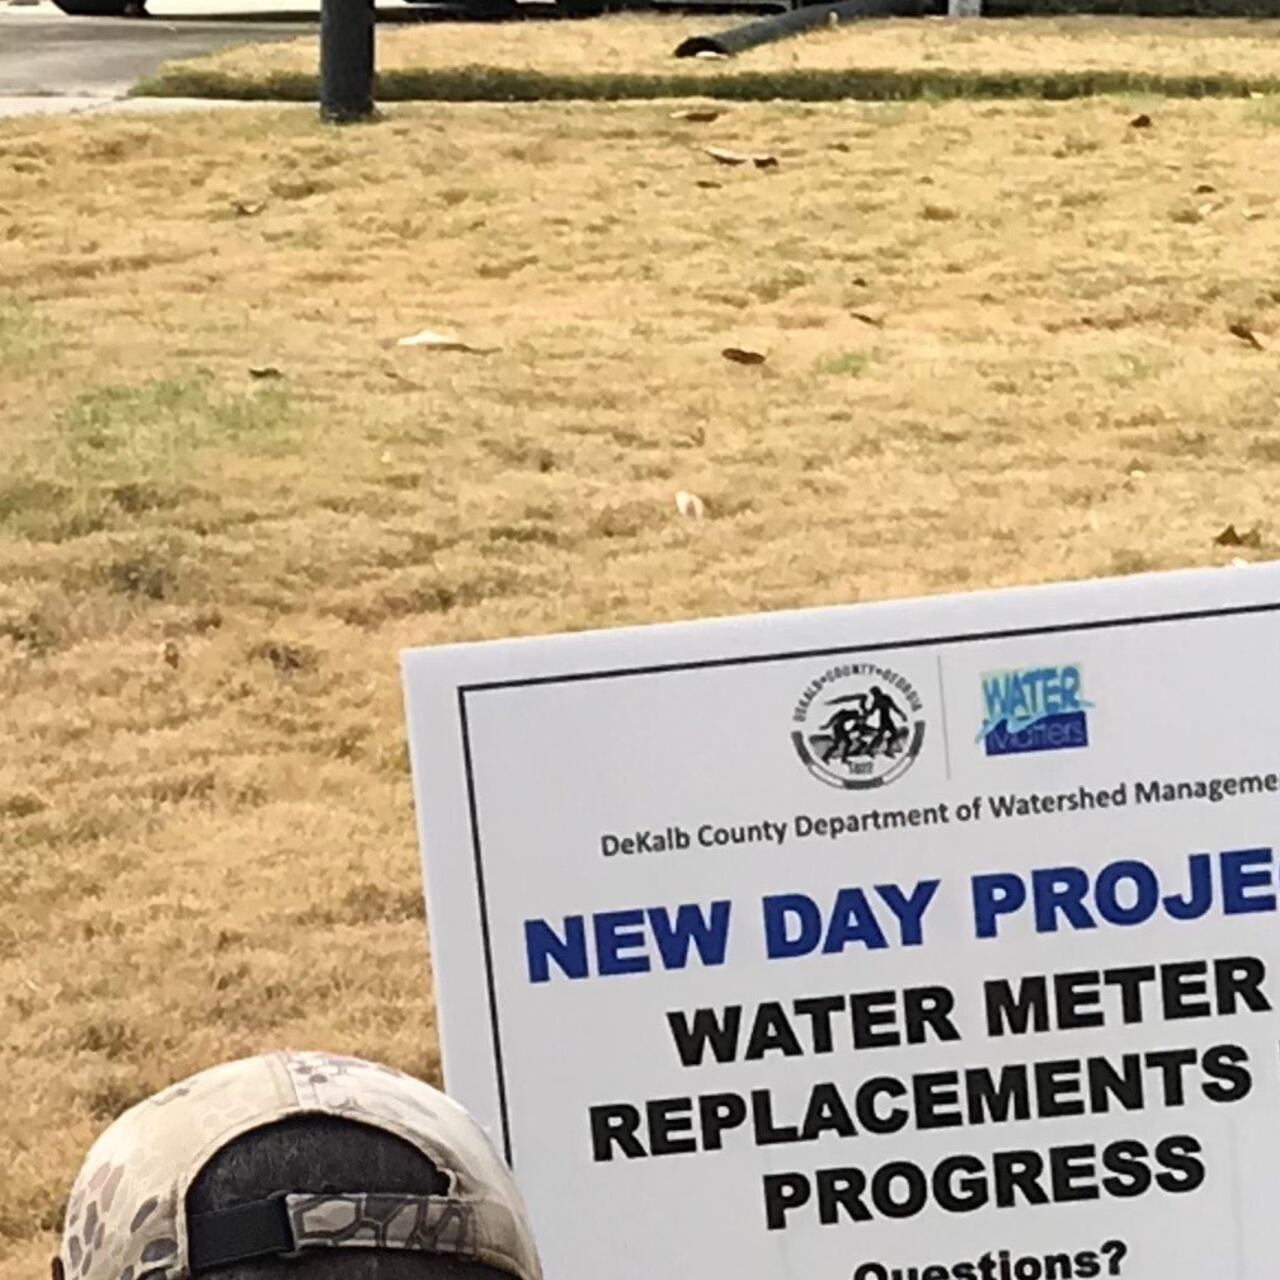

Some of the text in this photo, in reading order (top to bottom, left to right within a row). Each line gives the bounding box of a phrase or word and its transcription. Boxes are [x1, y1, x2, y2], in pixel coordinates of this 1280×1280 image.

[981, 665, 1081, 718] WATER
[985, 720, 1085, 751] Matters
[601, 827, 691, 858] DeKalb
[697, 820, 787, 849] County
[794, 803, 949, 841] Department
[955, 796, 982, 822] of
[988, 782, 1127, 819] Watershed
[523, 899, 732, 984] NEW
[761, 879, 941, 960] DAY
[665, 956, 1273, 1068] WATER METER
[588, 1044, 1253, 1163] REPLACEMENTS
[762, 1134, 1206, 1232] PROGRESS
